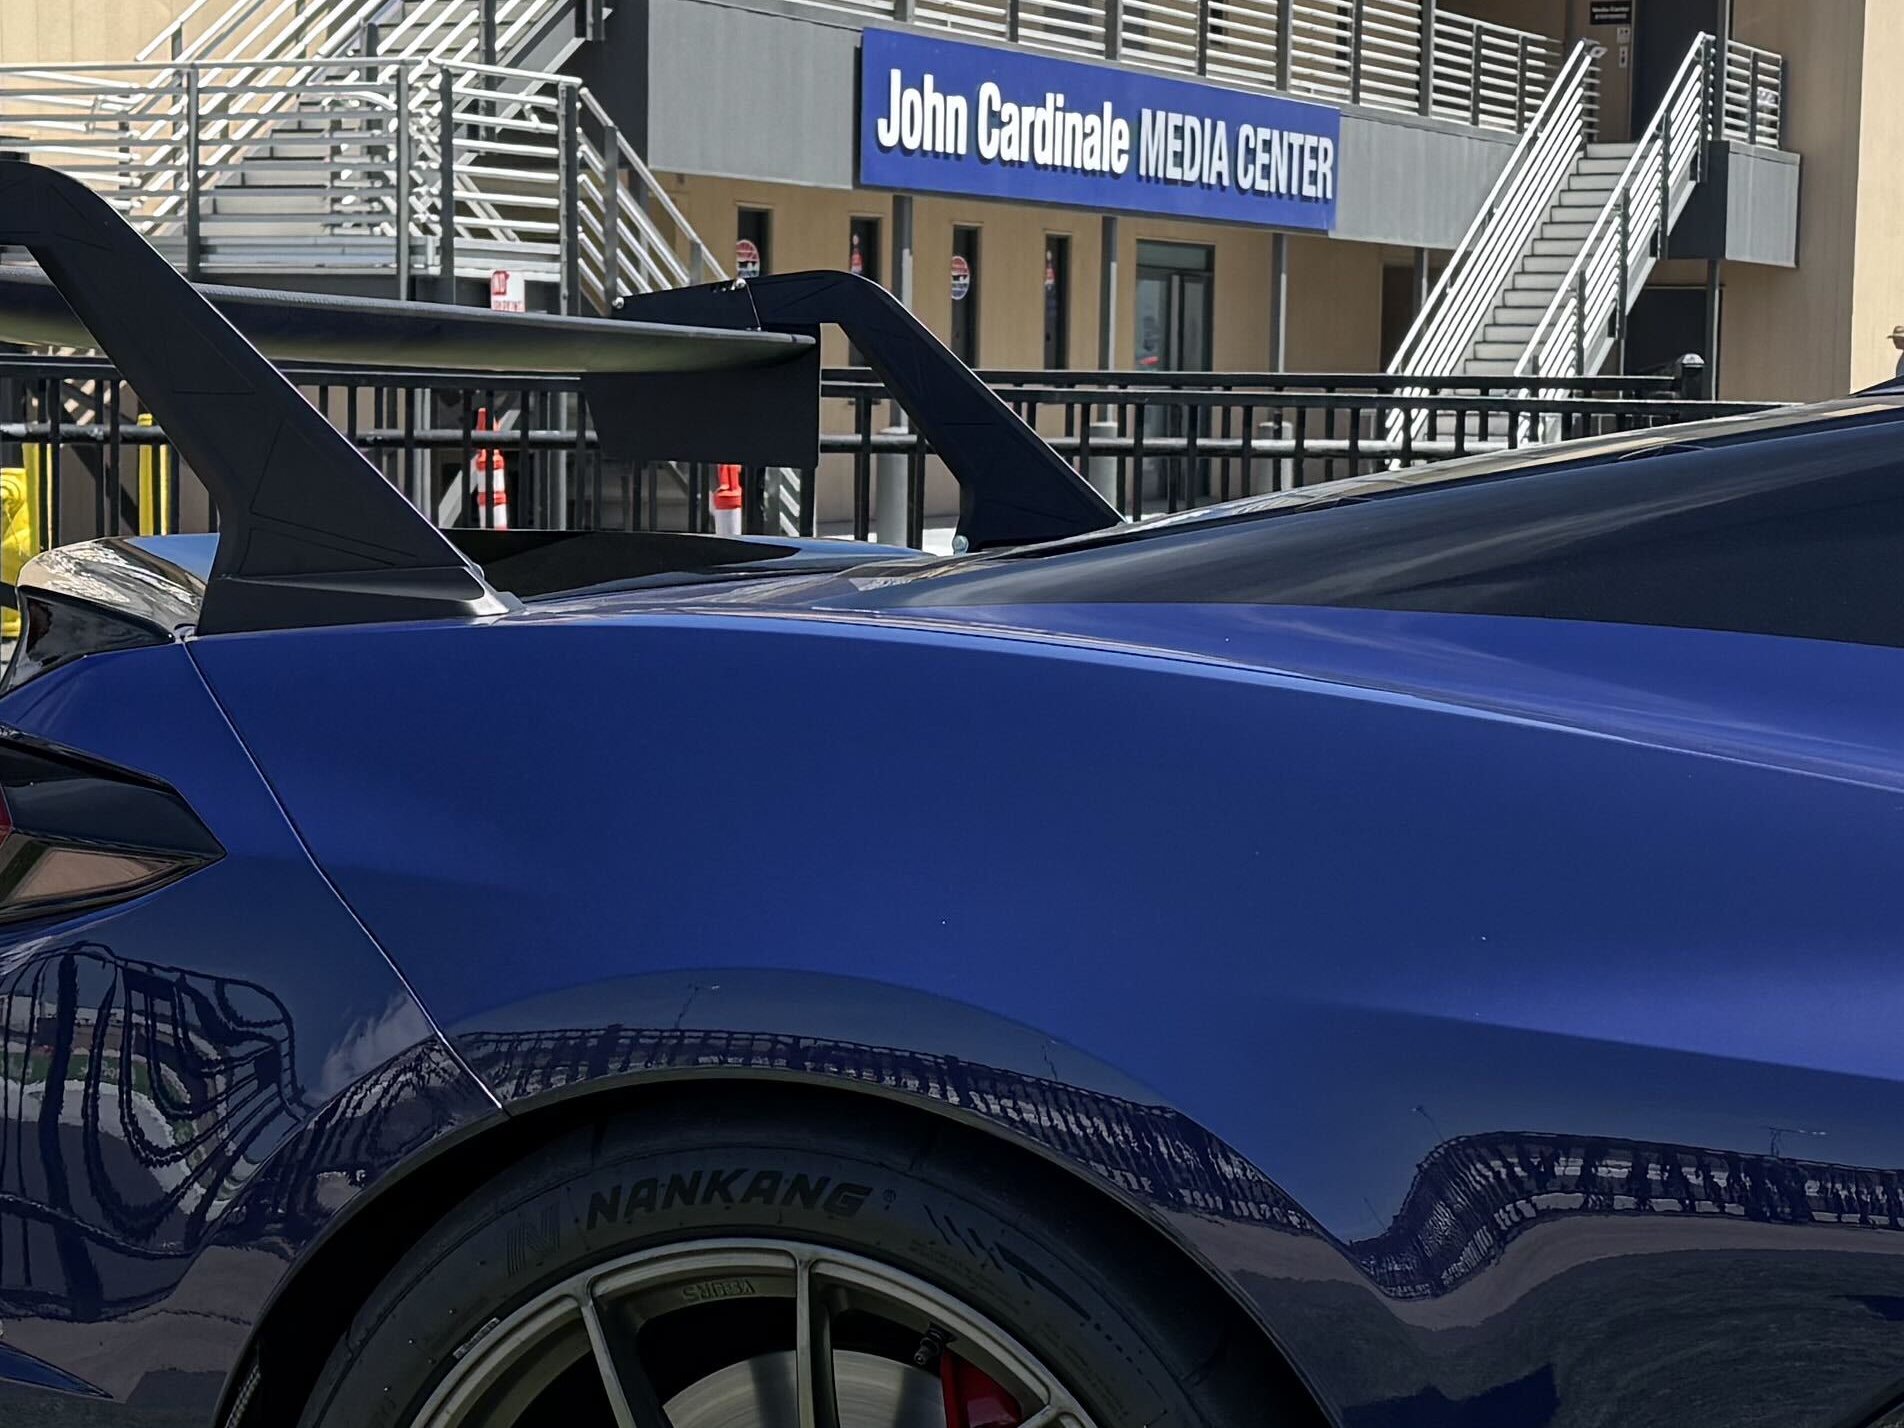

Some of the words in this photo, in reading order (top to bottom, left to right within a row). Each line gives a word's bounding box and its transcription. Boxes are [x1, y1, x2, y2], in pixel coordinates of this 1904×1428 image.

[877, 68, 968, 155] John
[977, 81, 1129, 174] Cardinale
[1139, 108, 1230, 186] MEDIA
[1237, 123, 1334, 199] CENTER
[586, 1168, 874, 1231] NANKANG
